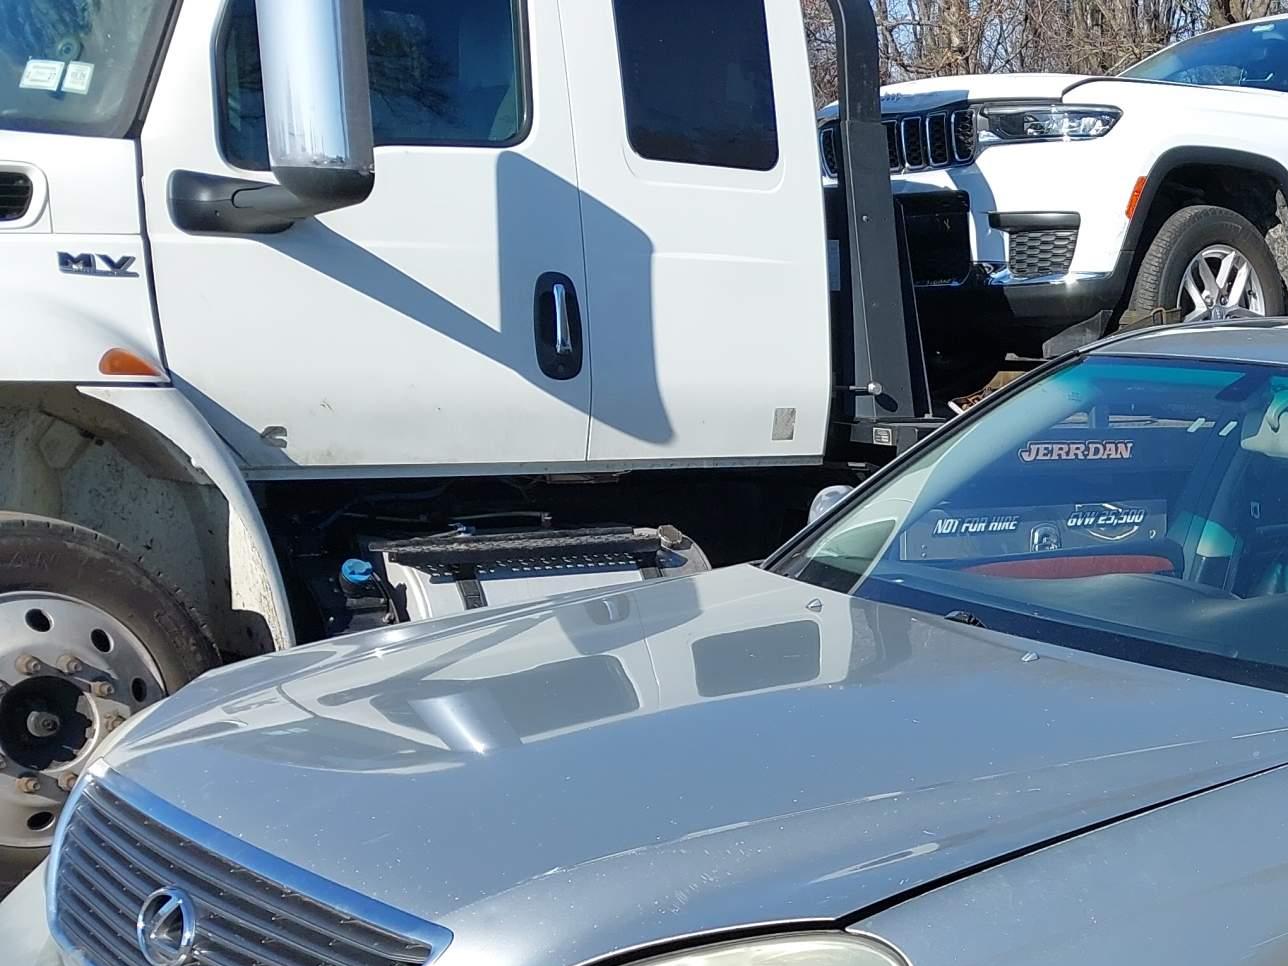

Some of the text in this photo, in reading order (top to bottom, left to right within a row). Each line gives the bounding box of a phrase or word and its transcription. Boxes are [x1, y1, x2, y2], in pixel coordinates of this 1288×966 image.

[57, 251, 138, 275] MV
[1020, 441, 1134, 462] JERR-DAN
[933, 515, 1020, 534] NOT FOR HIRE
[1067, 511, 1098, 526] GVW
